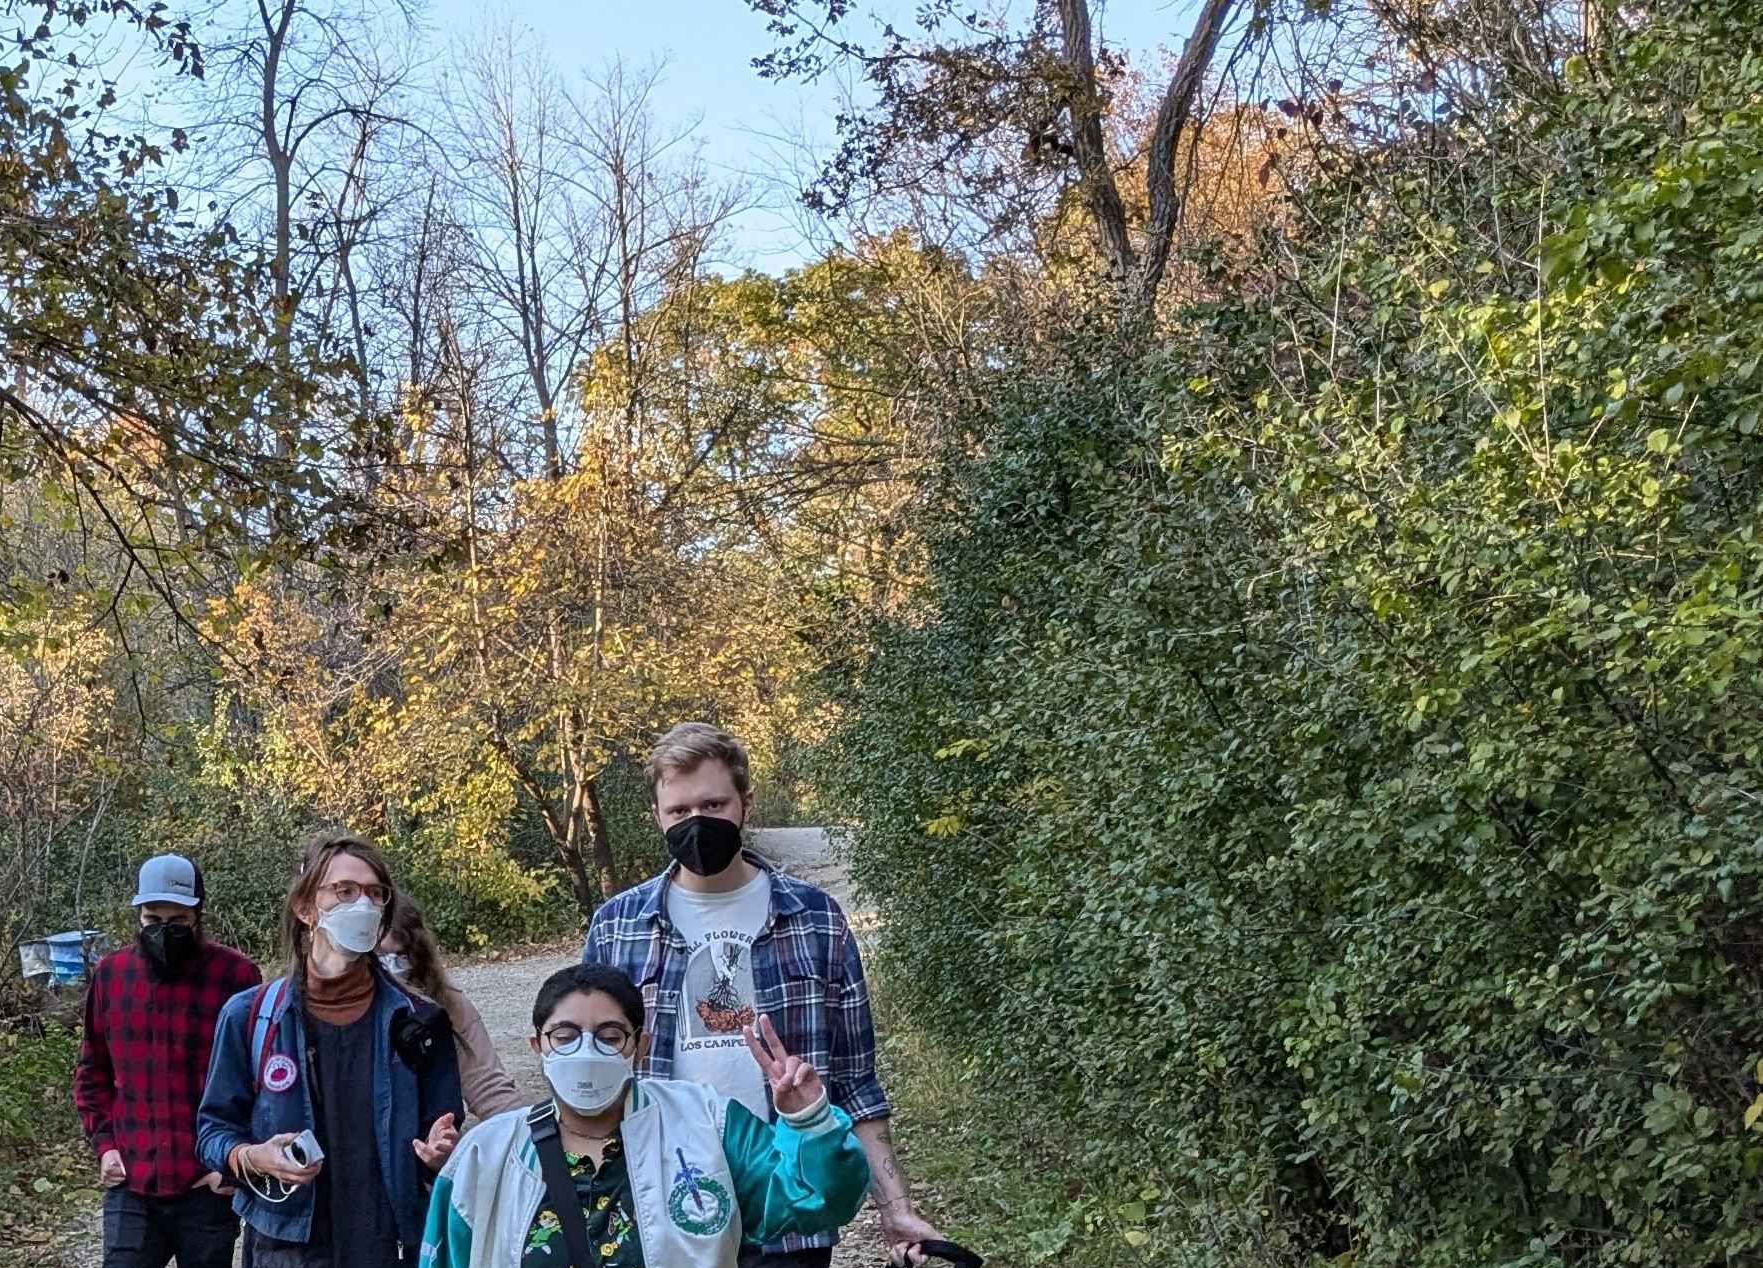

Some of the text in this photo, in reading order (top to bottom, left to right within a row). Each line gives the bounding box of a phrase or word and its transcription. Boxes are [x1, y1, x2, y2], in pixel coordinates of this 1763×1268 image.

[704, 930, 754, 945] FLOWER
[680, 1038, 750, 1052] LOS CAMPE
